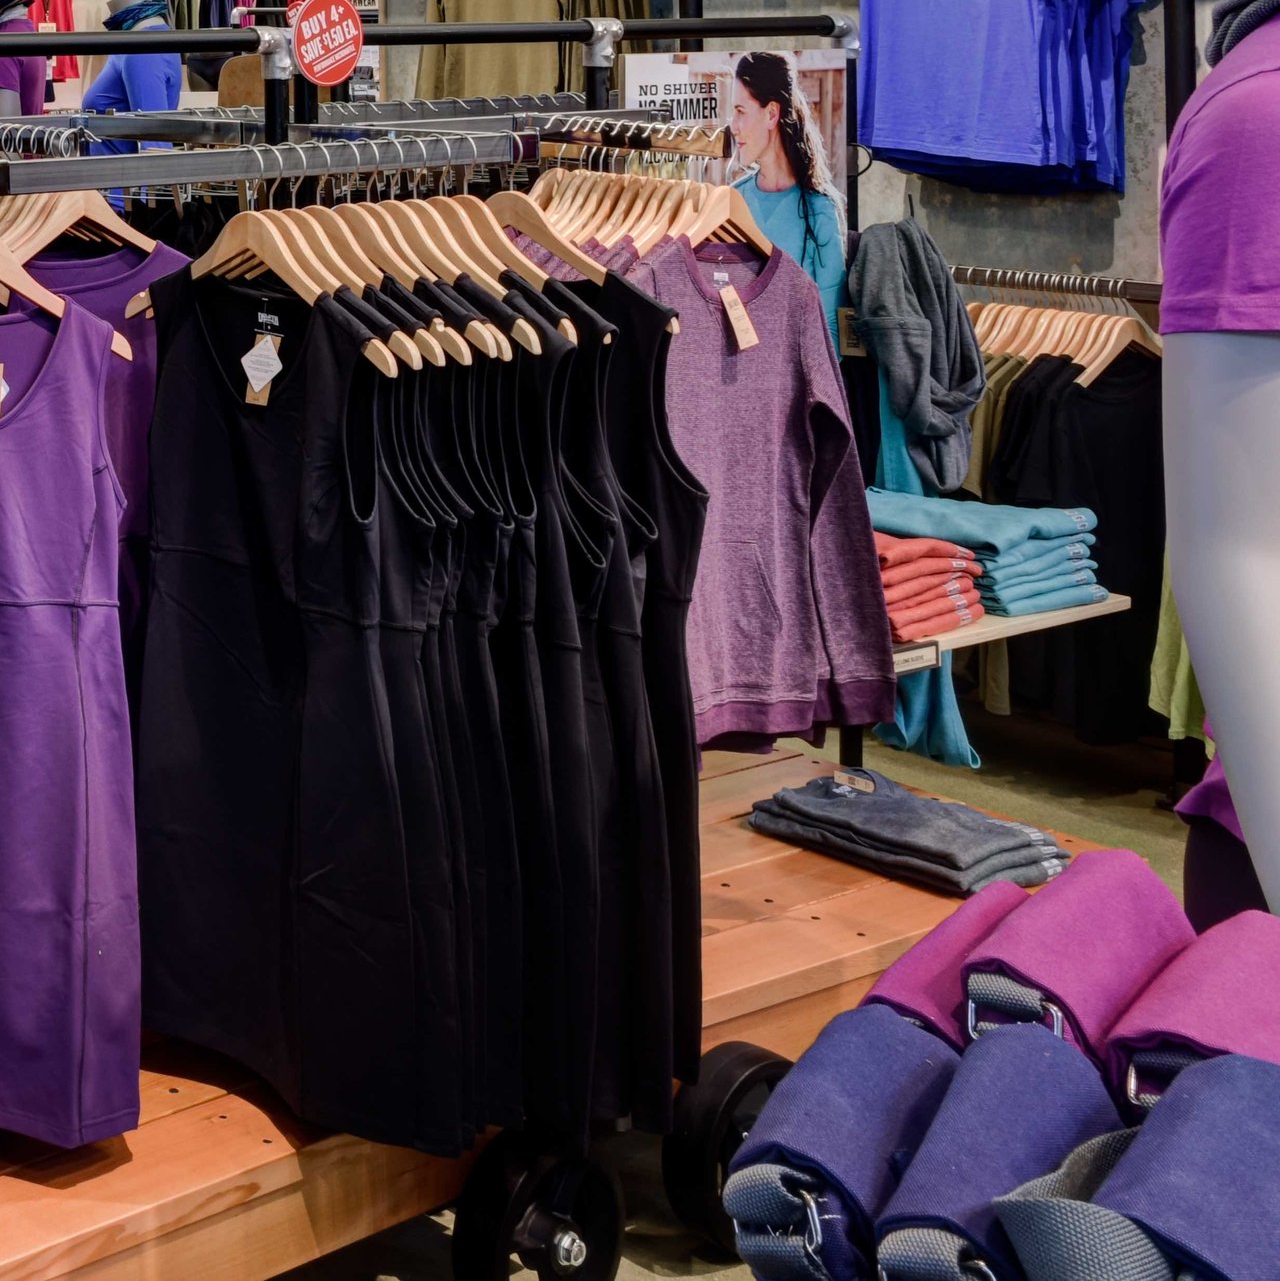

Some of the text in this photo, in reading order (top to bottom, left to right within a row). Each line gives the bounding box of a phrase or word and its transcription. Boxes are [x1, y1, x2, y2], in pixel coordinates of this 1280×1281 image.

[301, 10, 327, 40] BUY
[301, 36, 325, 64] SAVE
[322, 25, 345, 50] $1.50
[639, 83, 717, 96] NO SHIVER
